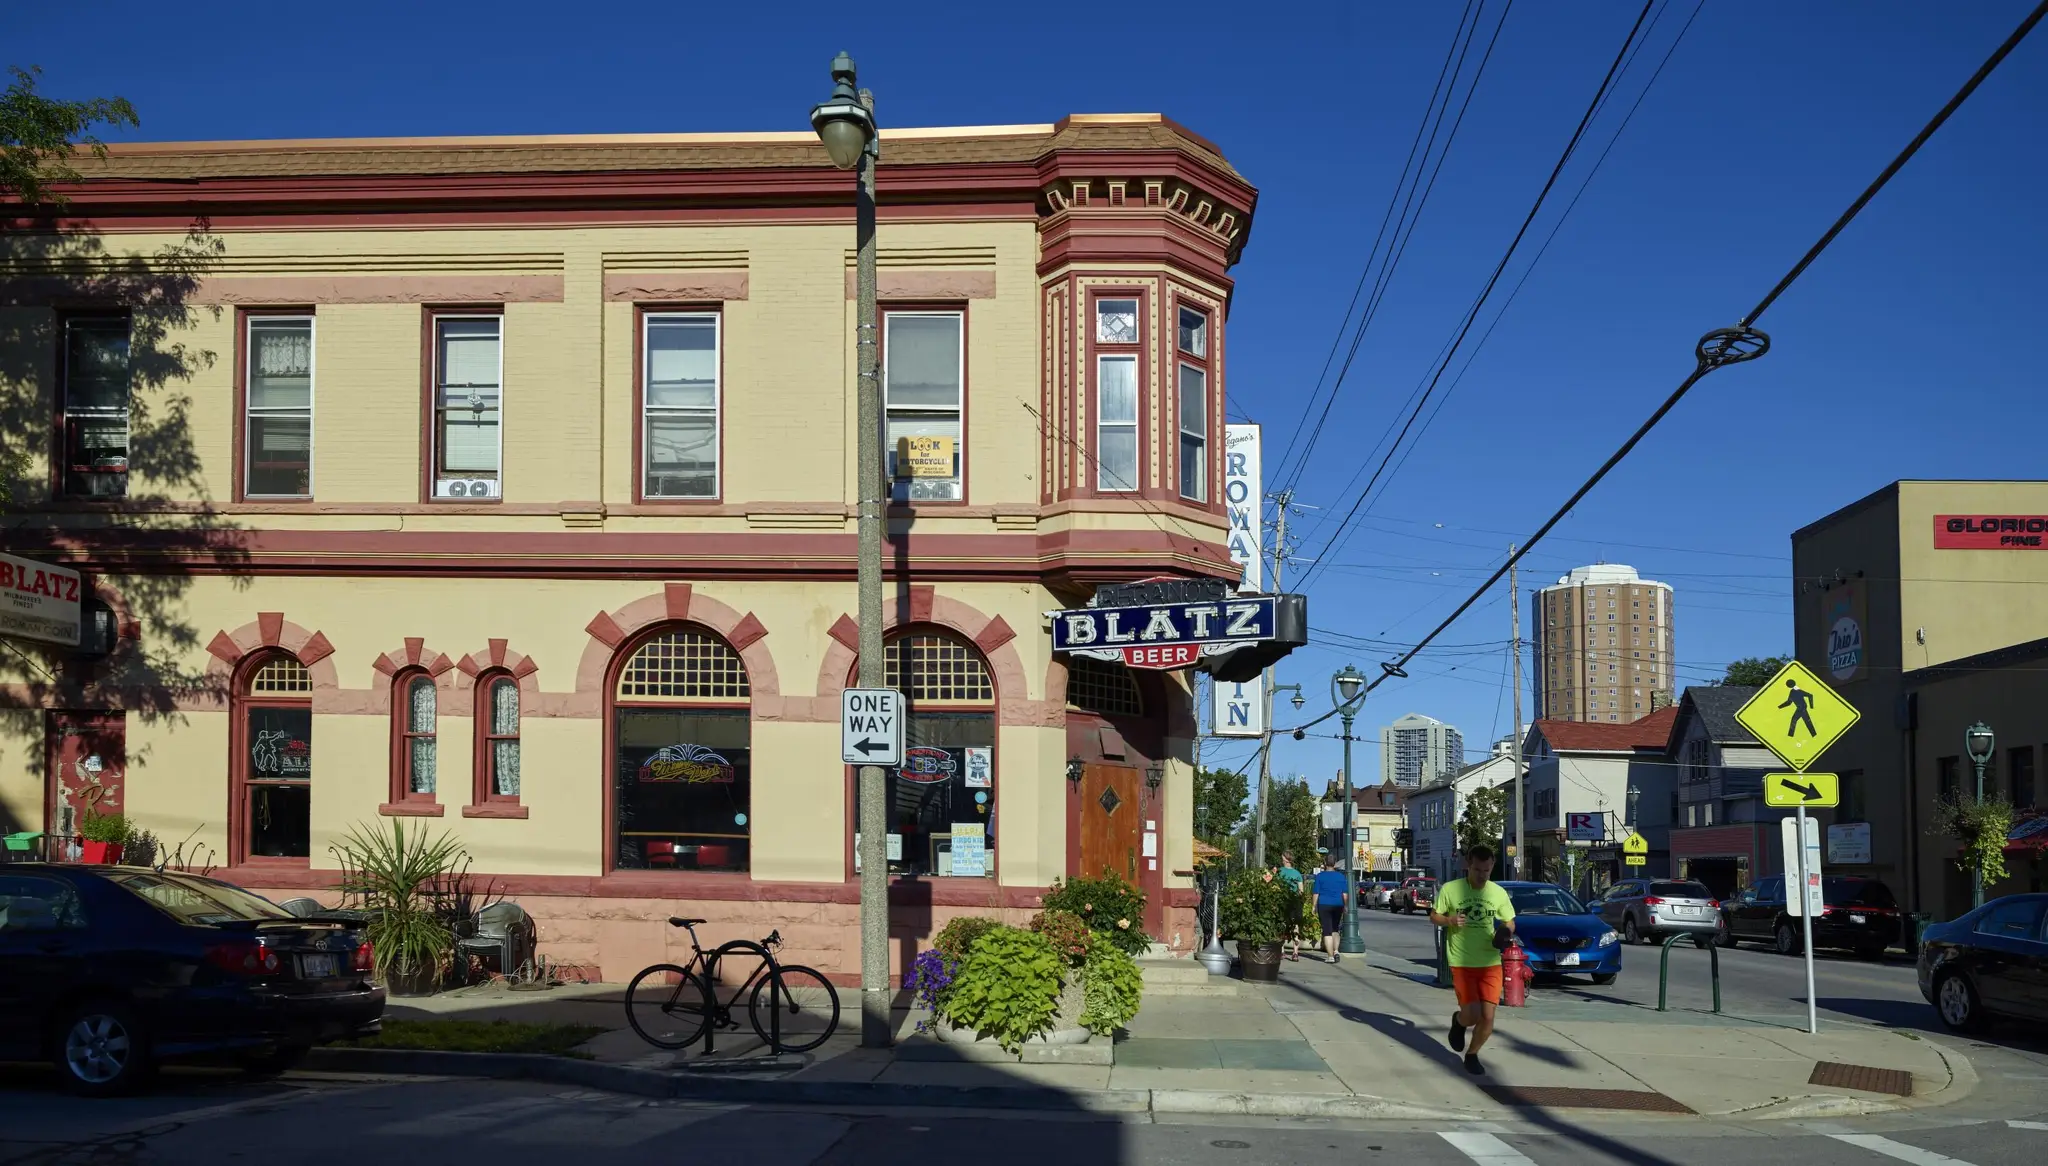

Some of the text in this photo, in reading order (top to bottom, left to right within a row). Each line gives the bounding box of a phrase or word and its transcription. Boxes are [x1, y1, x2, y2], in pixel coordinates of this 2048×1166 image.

[910, 438, 940, 451] LOOK
[1947, 518, 2048, 533] GLORIO
[2000, 535, 2042, 546] FINE
[0, 561, 79, 602] BLATZ
[2, 615, 72, 638] ROMAN COIN
[1065, 603, 1260, 644] BLATZ
[1133, 647, 1189, 664] BEER
[1831, 651, 1857, 671] PIZZA
[850, 695, 891, 712] ONE
[849, 716, 892, 733] WAY
[1571, 814, 1596, 829] R
